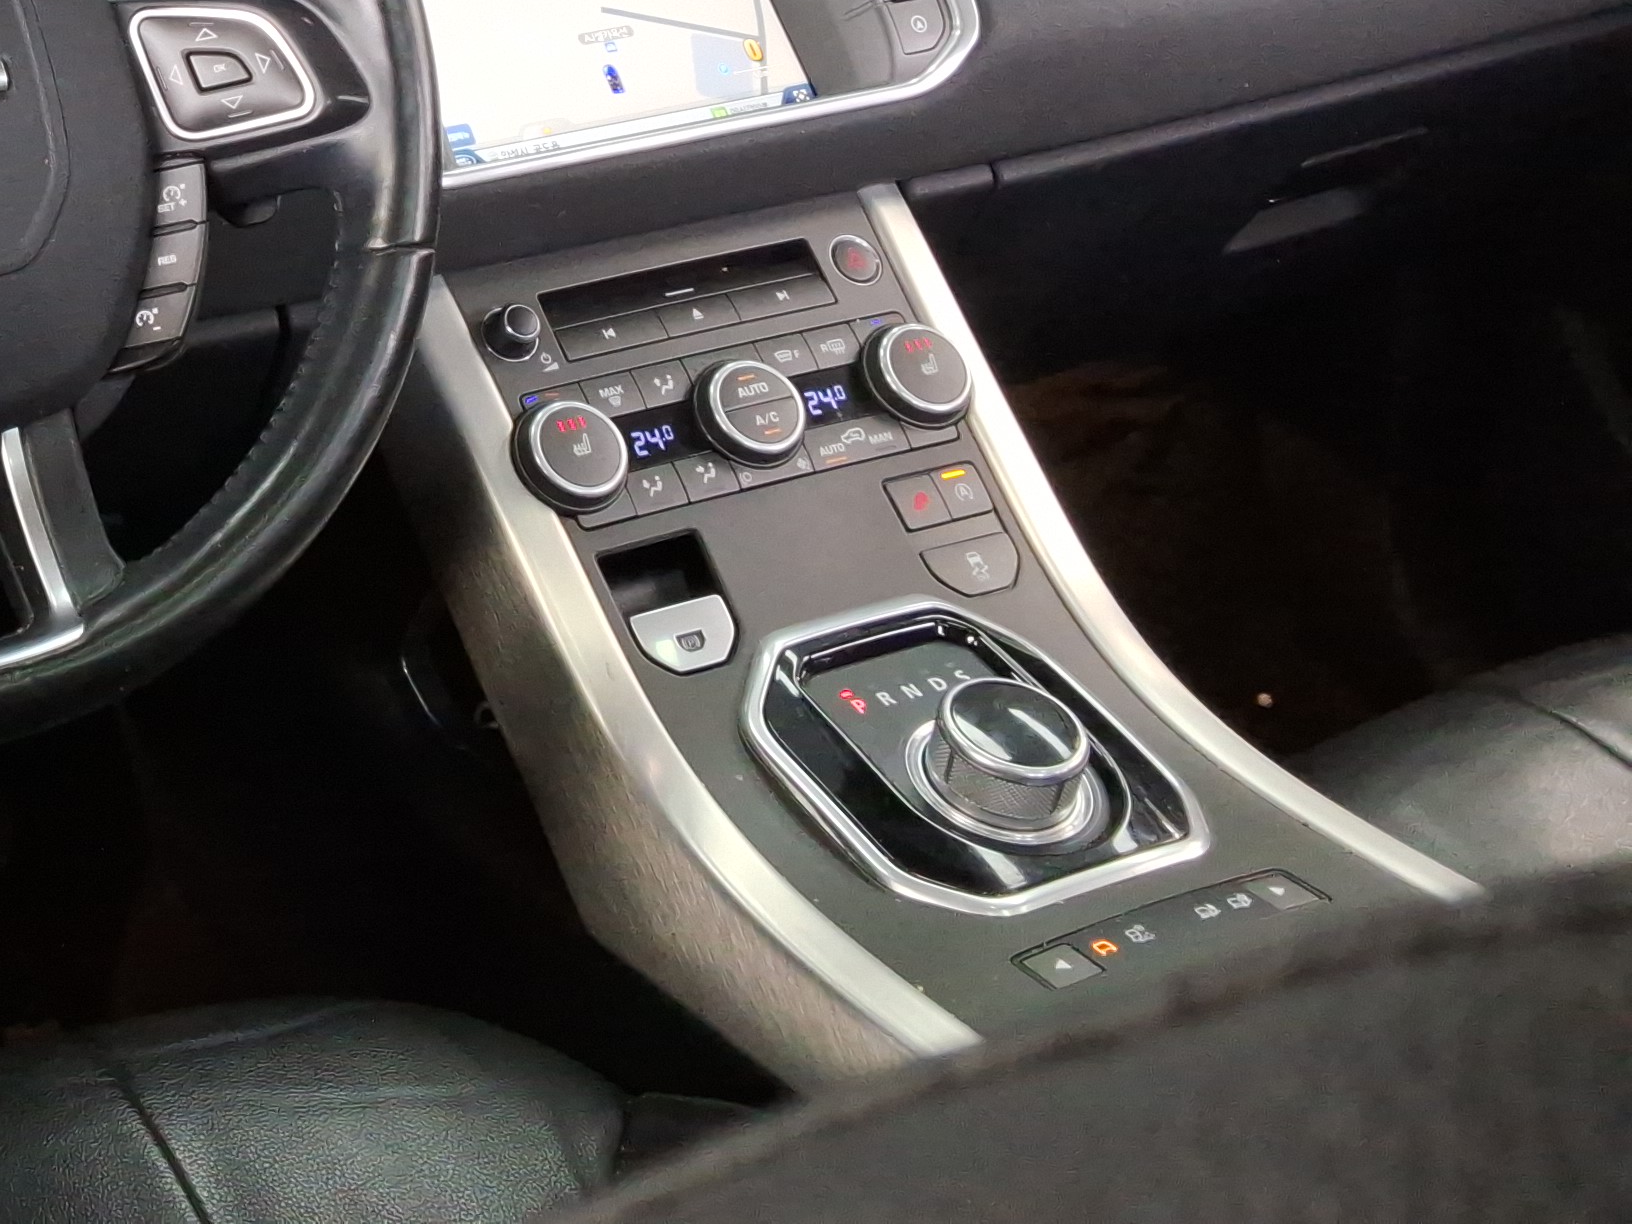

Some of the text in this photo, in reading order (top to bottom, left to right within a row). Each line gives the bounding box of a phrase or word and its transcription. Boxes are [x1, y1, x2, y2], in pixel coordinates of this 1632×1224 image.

[598, 385, 625, 399] MAX
[737, 382, 769, 398] AUTO
[755, 411, 780, 426] A/C
[819, 431, 894, 457] AUTO MAN
[875, 691, 897, 706] R
[900, 683, 924, 699] N
[927, 677, 948, 691] D
